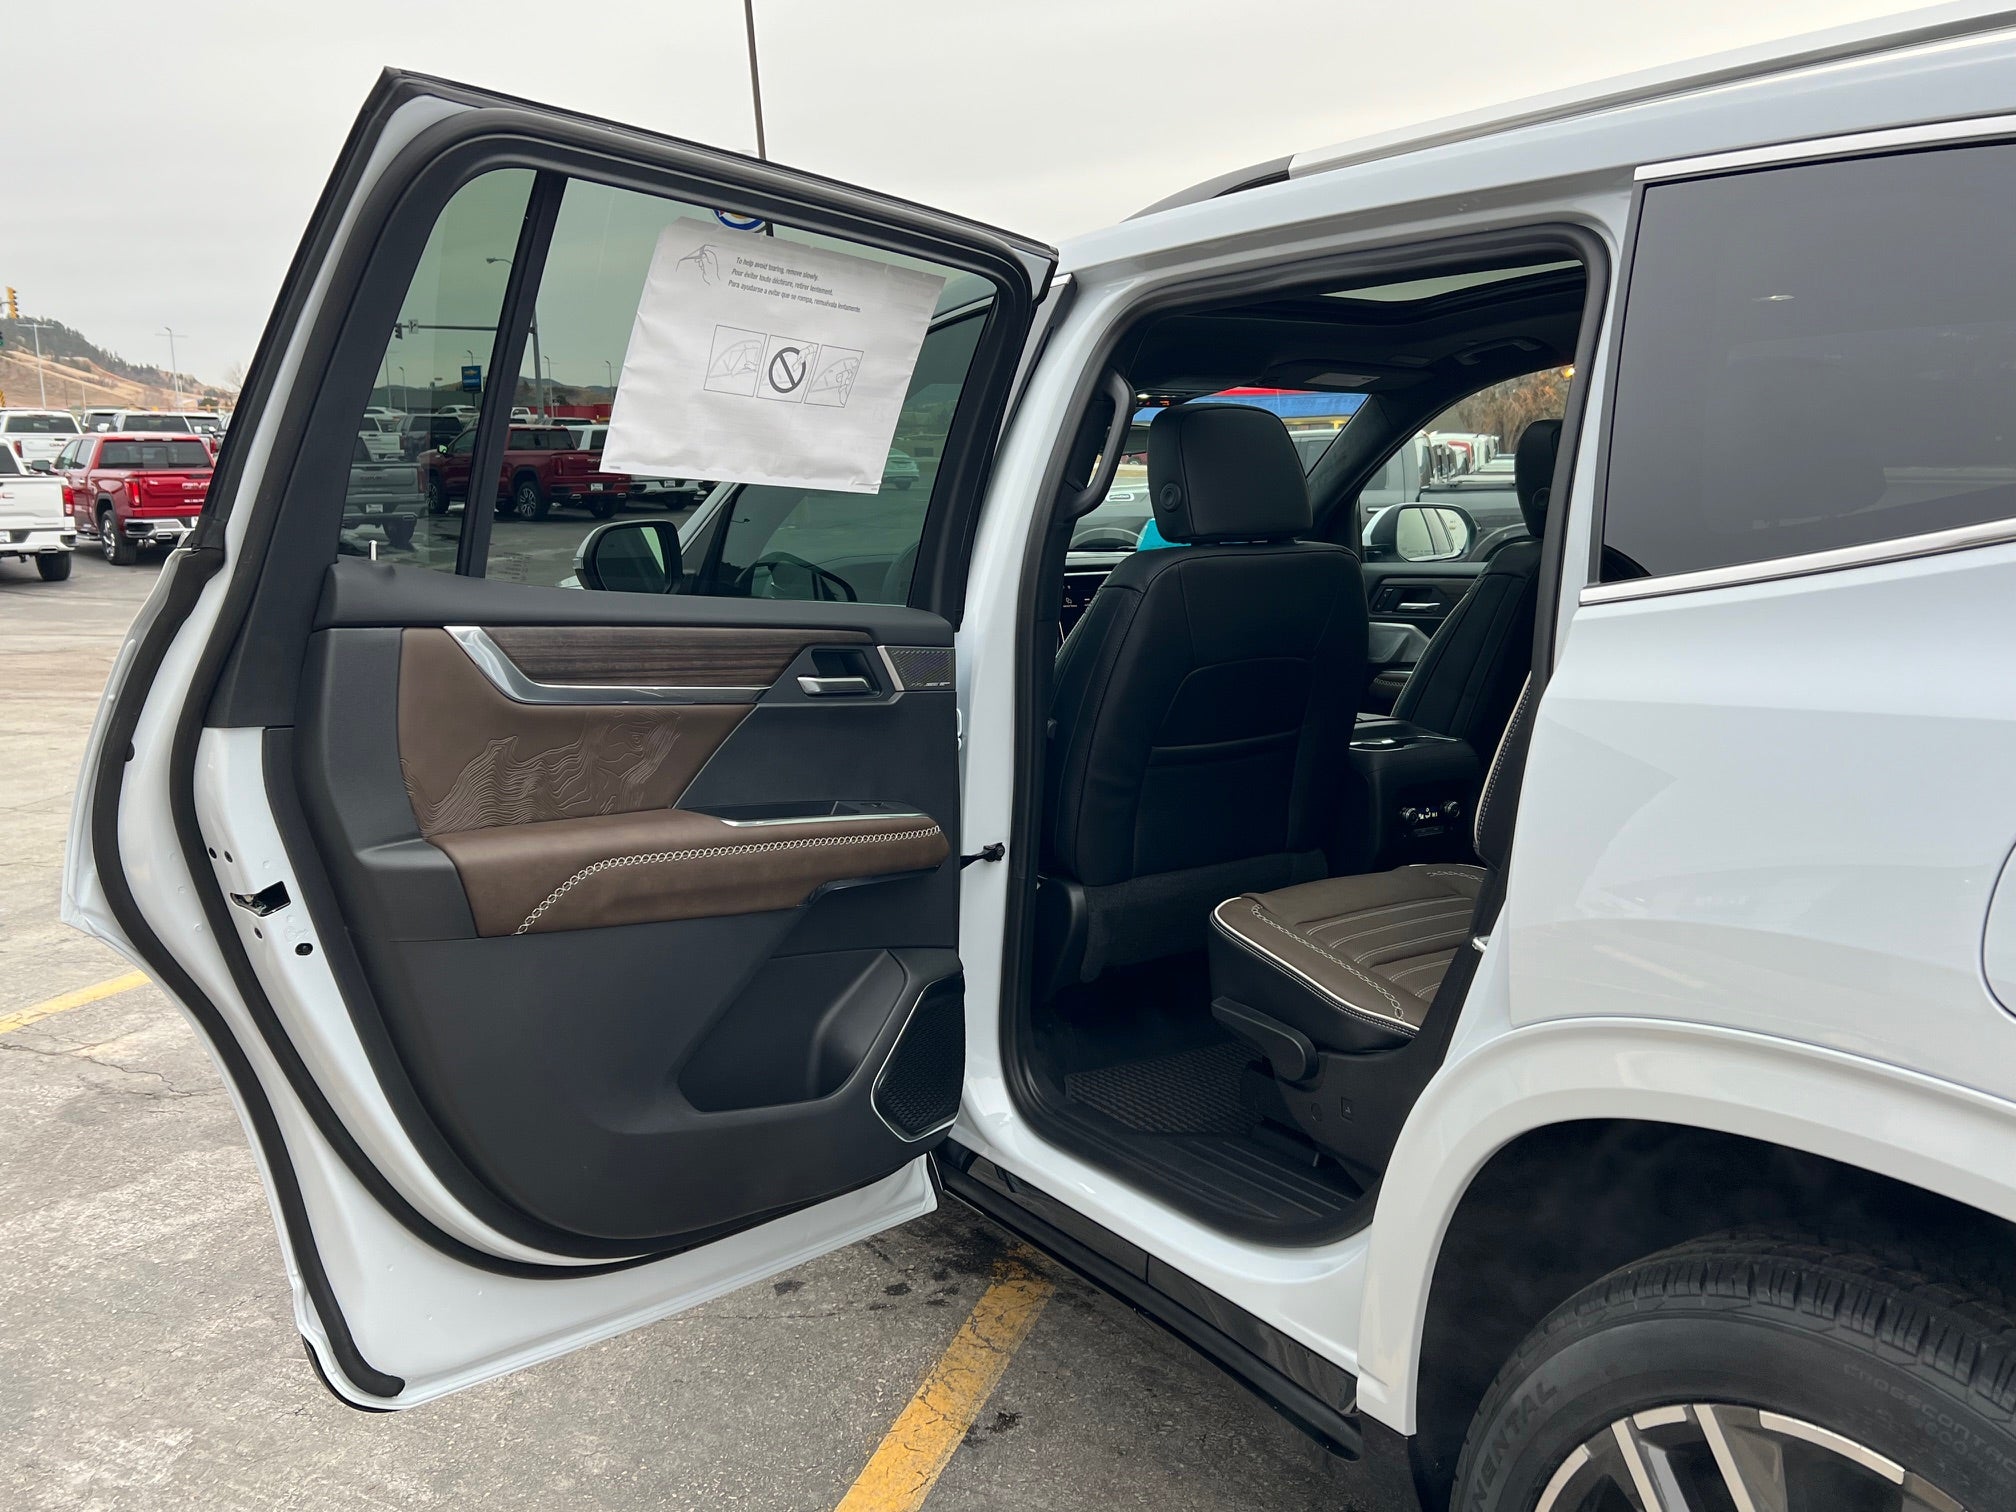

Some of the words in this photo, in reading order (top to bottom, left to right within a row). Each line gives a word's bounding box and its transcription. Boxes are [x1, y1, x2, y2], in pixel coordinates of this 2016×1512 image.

[732, 268, 743, 276] Pour
[743, 259, 754, 267] help
[786, 268, 802, 277] remove
[728, 279, 740, 288] Para
